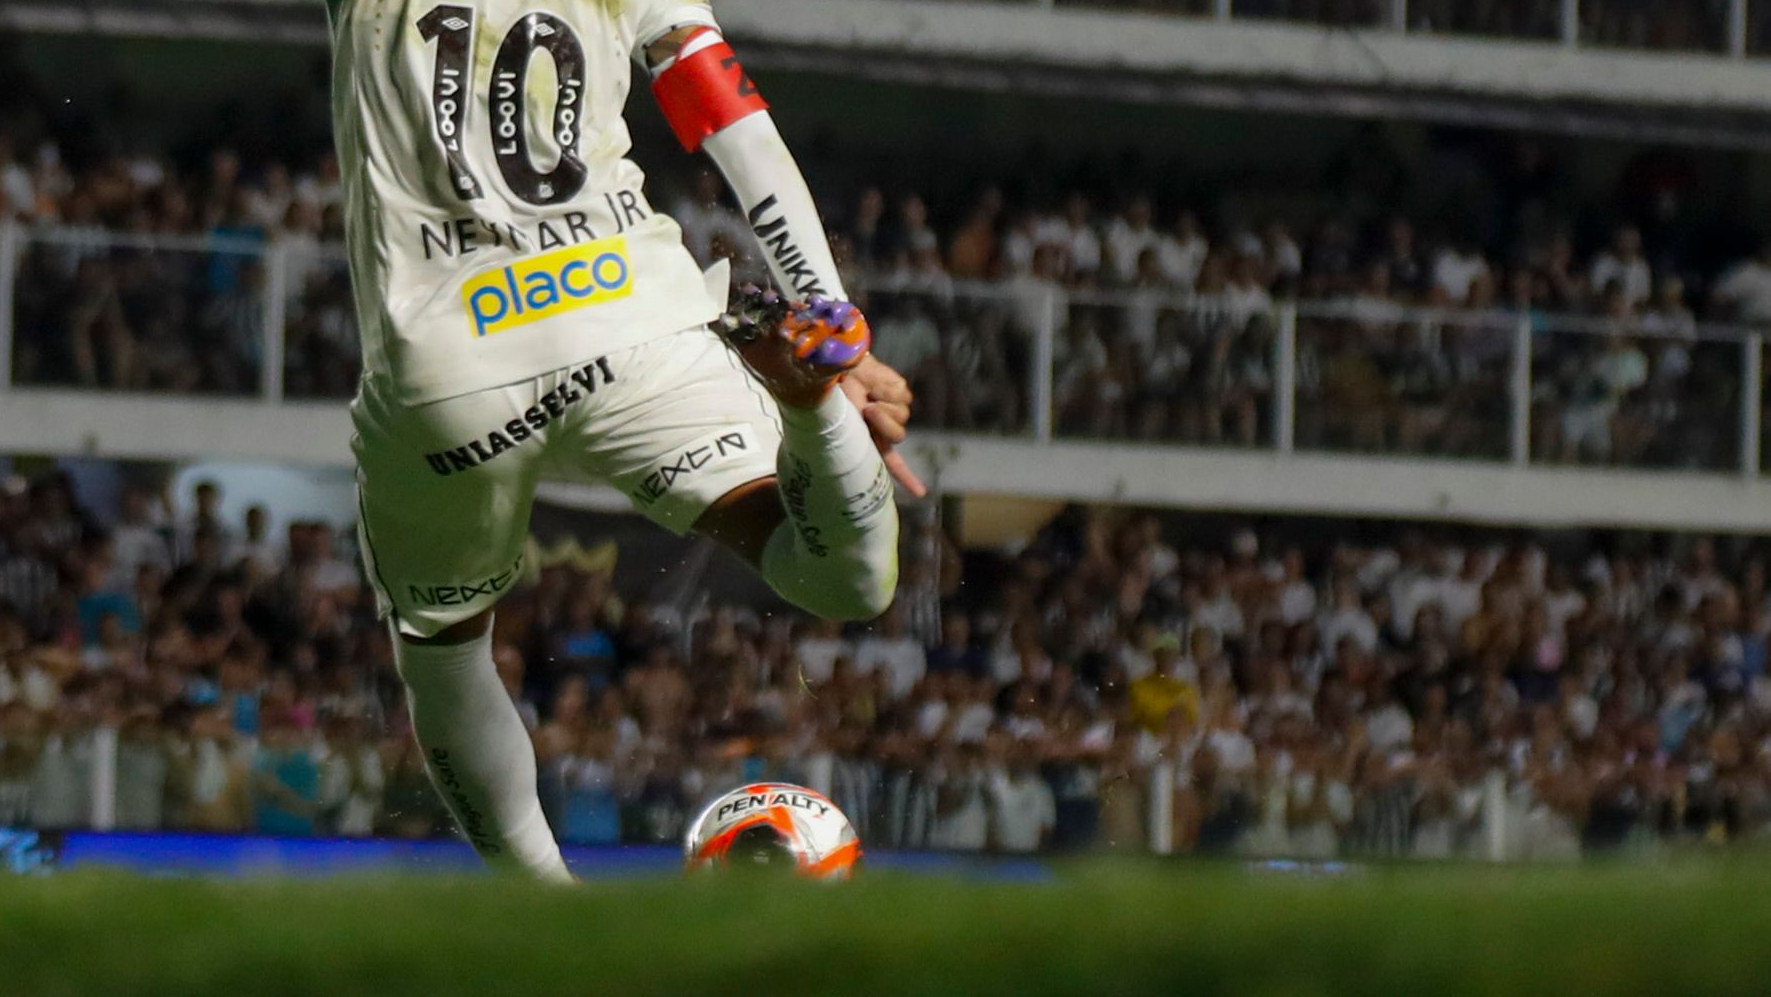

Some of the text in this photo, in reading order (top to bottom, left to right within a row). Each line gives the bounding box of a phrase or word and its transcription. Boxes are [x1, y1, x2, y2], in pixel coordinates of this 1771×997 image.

[415, 4, 588, 206] 10
[439, 68, 460, 151] LOOVI
[499, 72, 518, 155] LOOVI
[558, 78, 581, 152] OOVI
[604, 189, 646, 233] JR
[748, 193, 828, 302] UNIKK
[469, 253, 628, 336] placo
[424, 355, 616, 476] UNIASSELVI
[408, 554, 523, 606] NEXE
[717, 793, 830, 822] PENALTY
